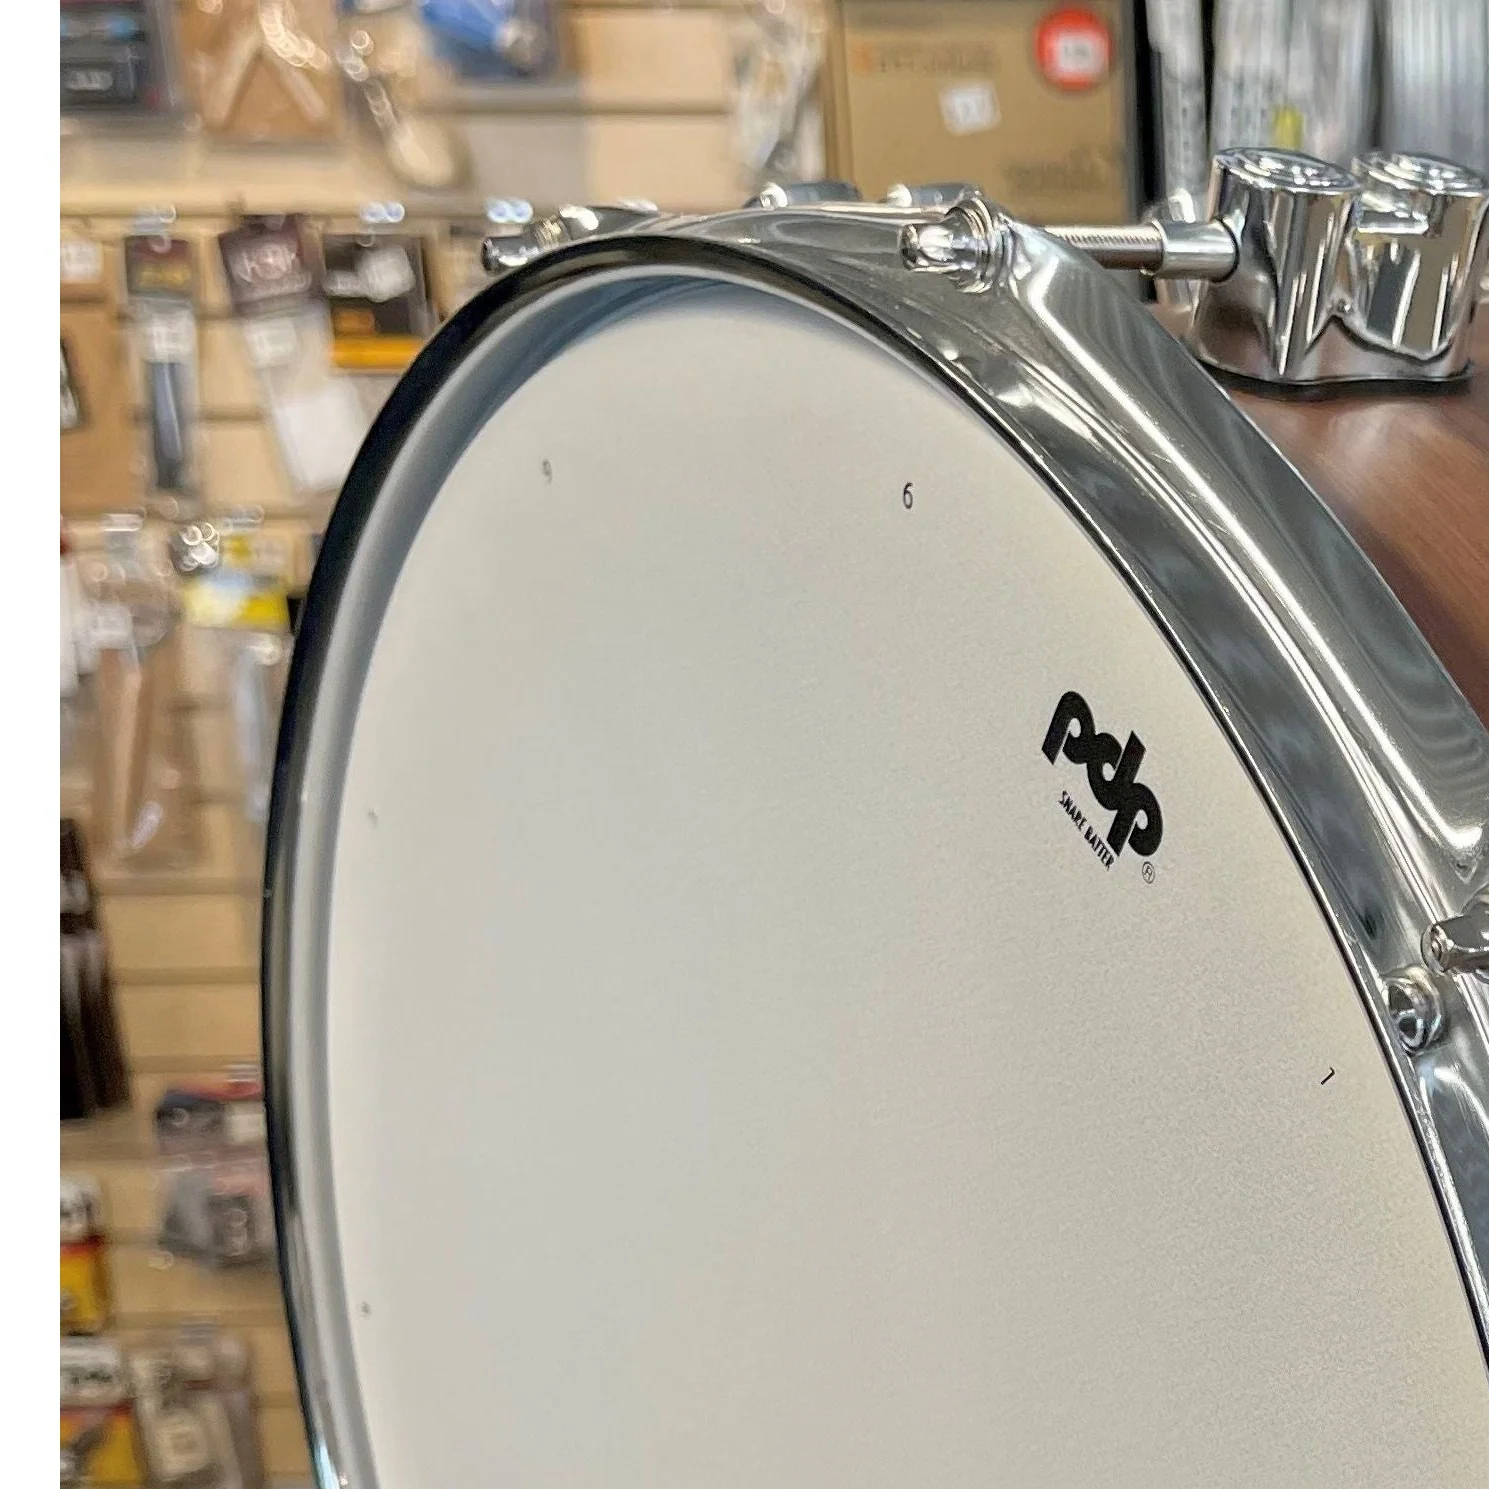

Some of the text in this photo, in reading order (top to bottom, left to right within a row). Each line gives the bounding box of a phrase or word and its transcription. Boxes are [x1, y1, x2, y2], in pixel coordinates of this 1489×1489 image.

[903, 482, 914, 509] 6
[1041, 691, 1163, 857] pdp
[1059, 790, 1115, 871] SNARE BATTER
